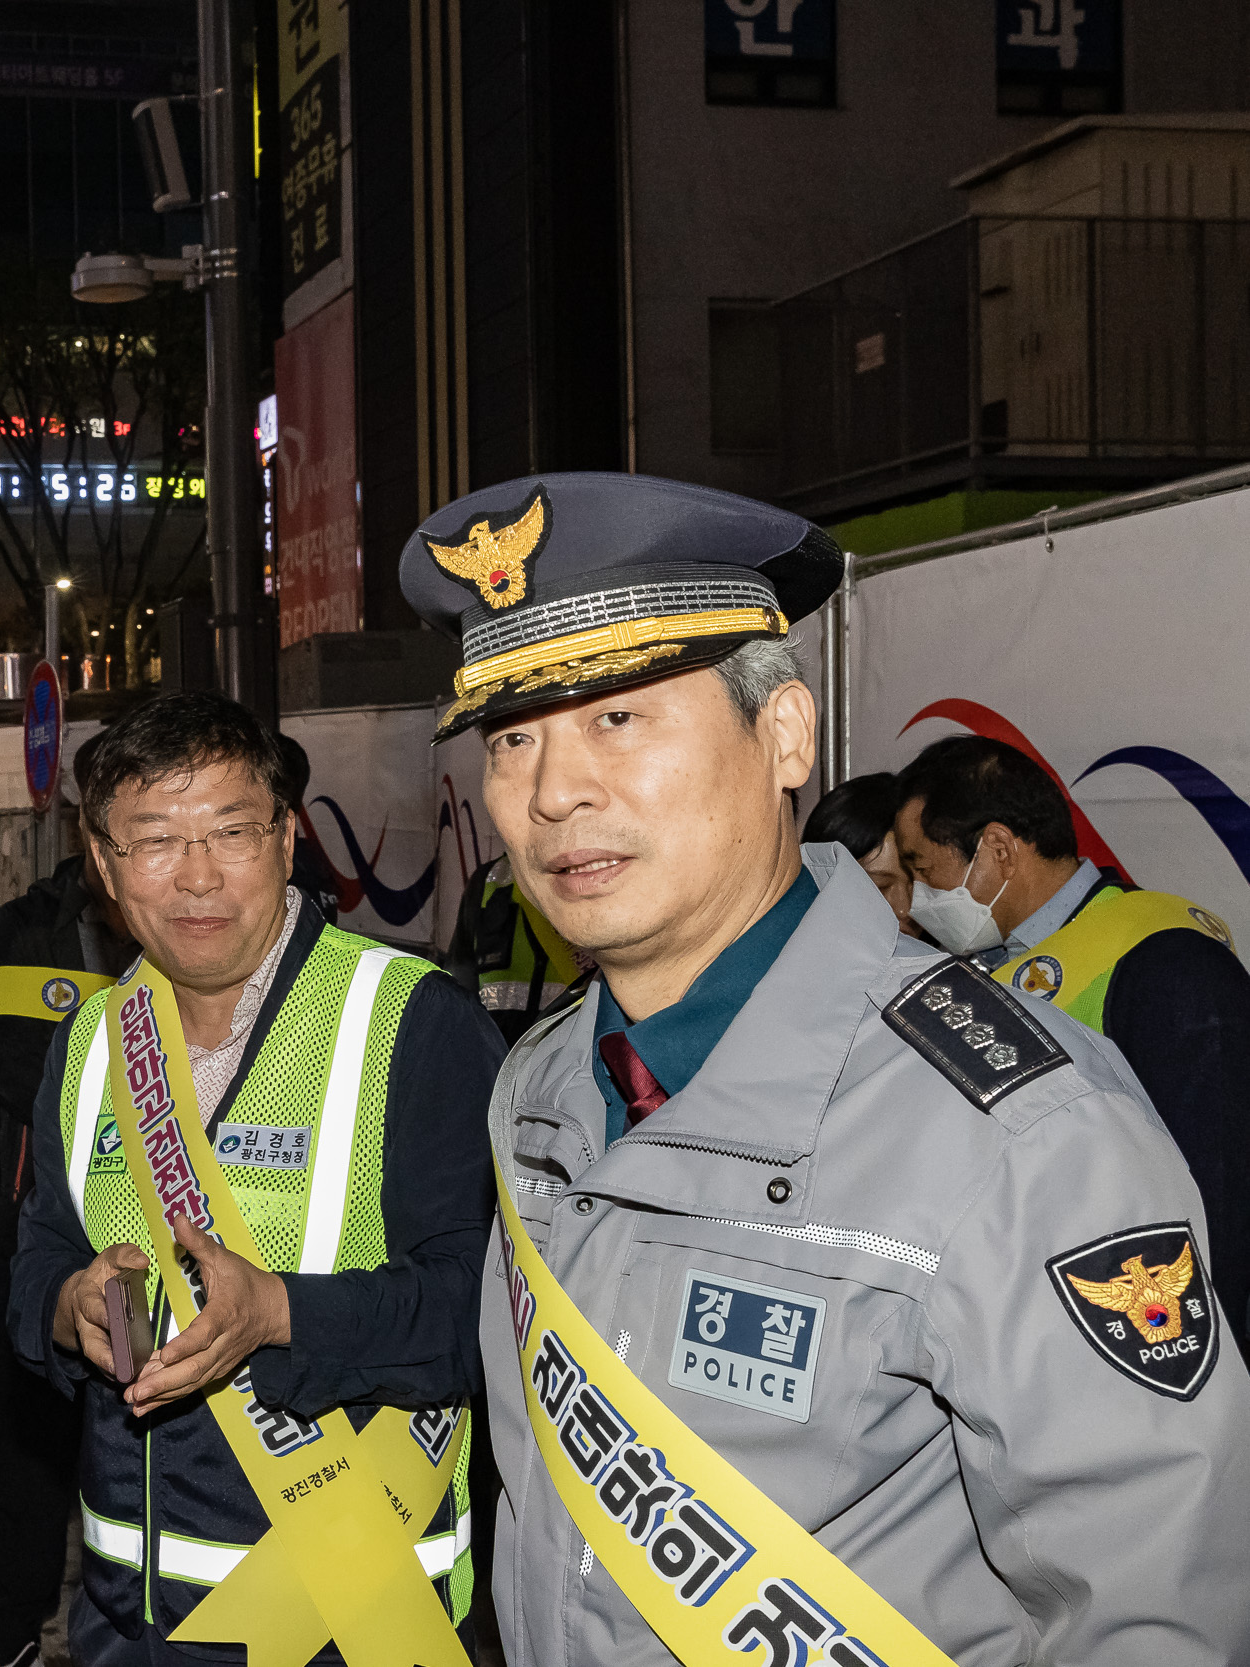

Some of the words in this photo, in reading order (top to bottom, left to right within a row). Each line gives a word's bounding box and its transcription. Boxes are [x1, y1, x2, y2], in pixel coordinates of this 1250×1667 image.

[290, 82, 323, 152] 365
[282, 131, 338, 222] 연중무휴
[113, 420, 131, 437] 3F
[120, 983, 175, 1135] 안전하고
[92, 1156, 126, 1169] 광진구
[143, 1115, 214, 1232] 건전한
[240, 1148, 304, 1164] 광진구청장
[693, 1285, 808, 1365] 경찰
[1138, 1334, 1201, 1365] POLICE
[682, 1349, 797, 1404] POLICE
[280, 1456, 351, 1505] 광진경찰서
[531, 1329, 758, 1608] 건대맛의
